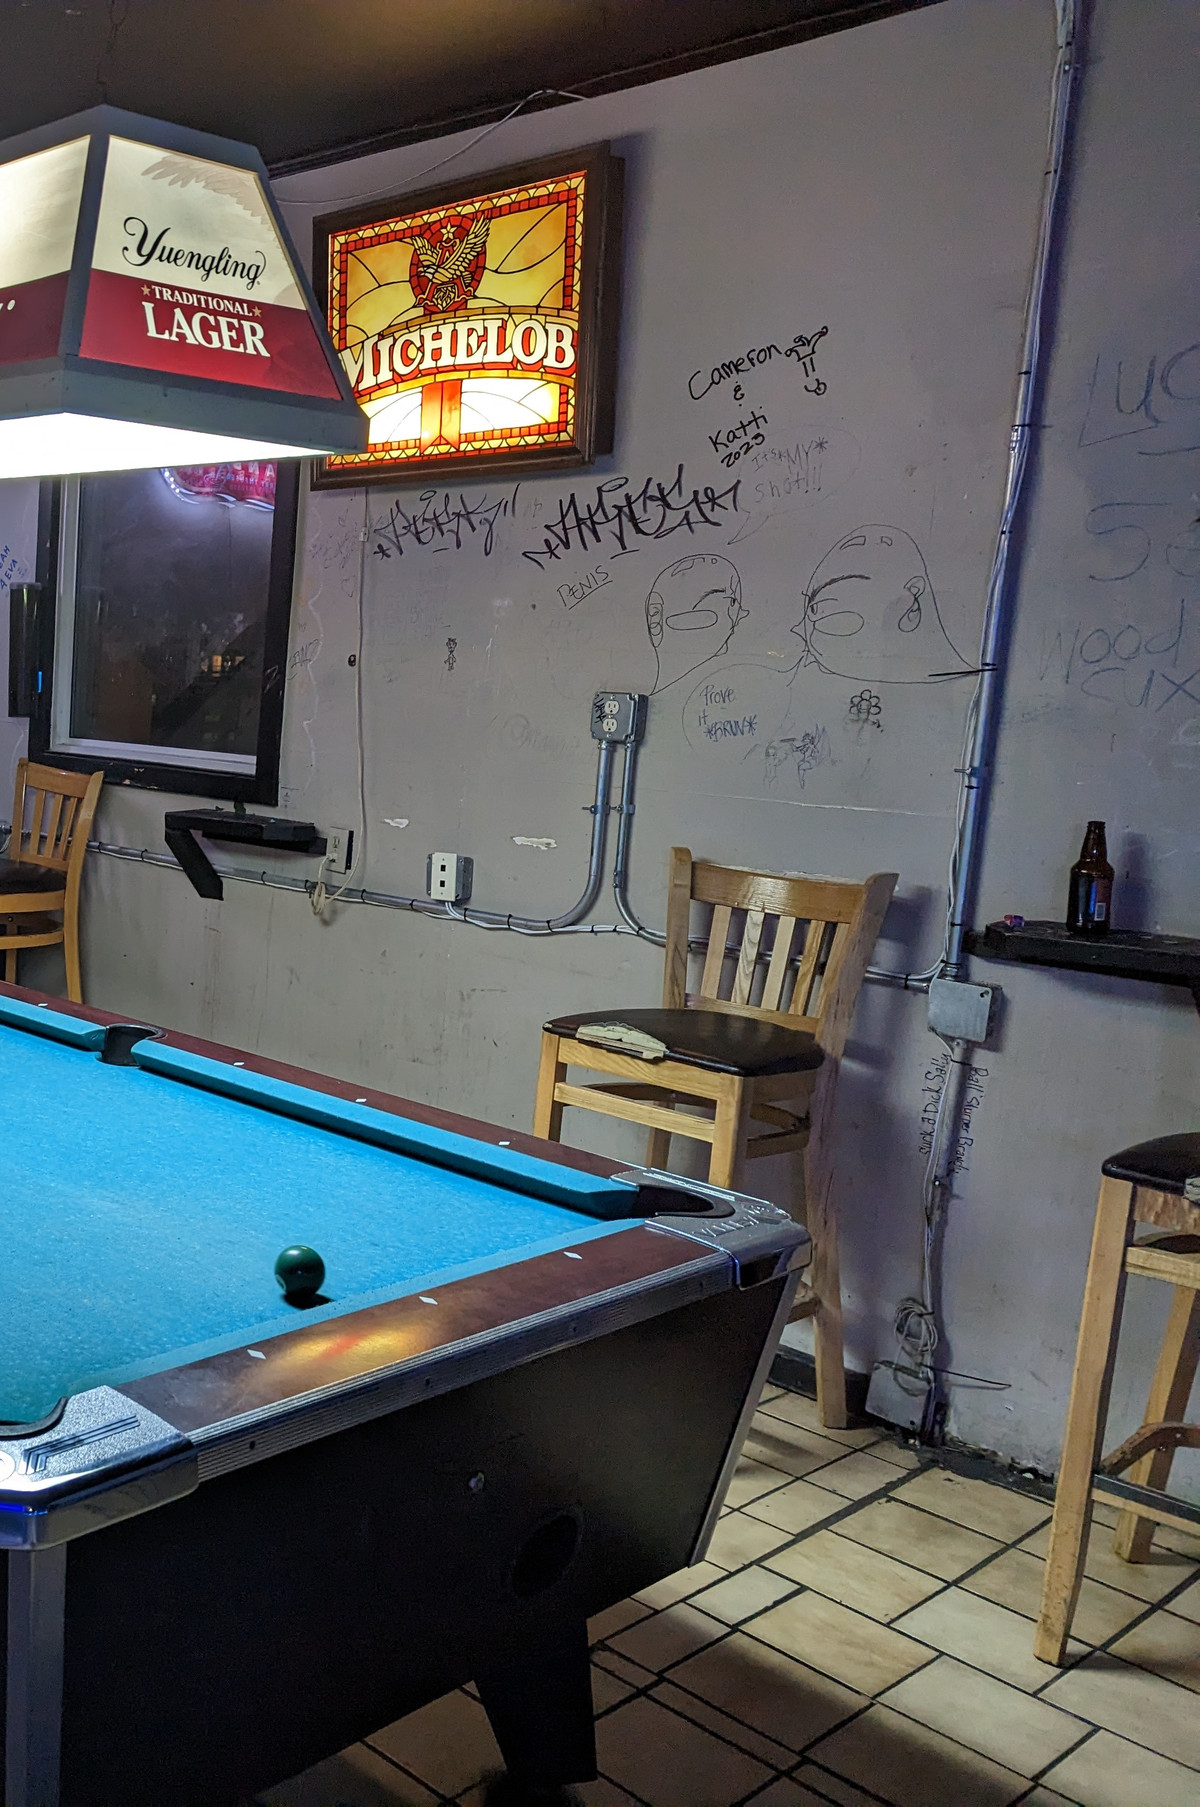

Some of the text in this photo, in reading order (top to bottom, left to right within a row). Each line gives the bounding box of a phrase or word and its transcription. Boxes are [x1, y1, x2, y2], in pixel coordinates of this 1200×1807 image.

[122, 216, 267, 291] Yuengling
[151, 285, 253, 317] TRADITIONAL
[142, 301, 271, 358] LAGER
[337, 318, 576, 392] MICHELOB
[688, 344, 782, 400] Cameron
[720, 432, 766, 468] 2023
[700, 684, 735, 706] Prove
